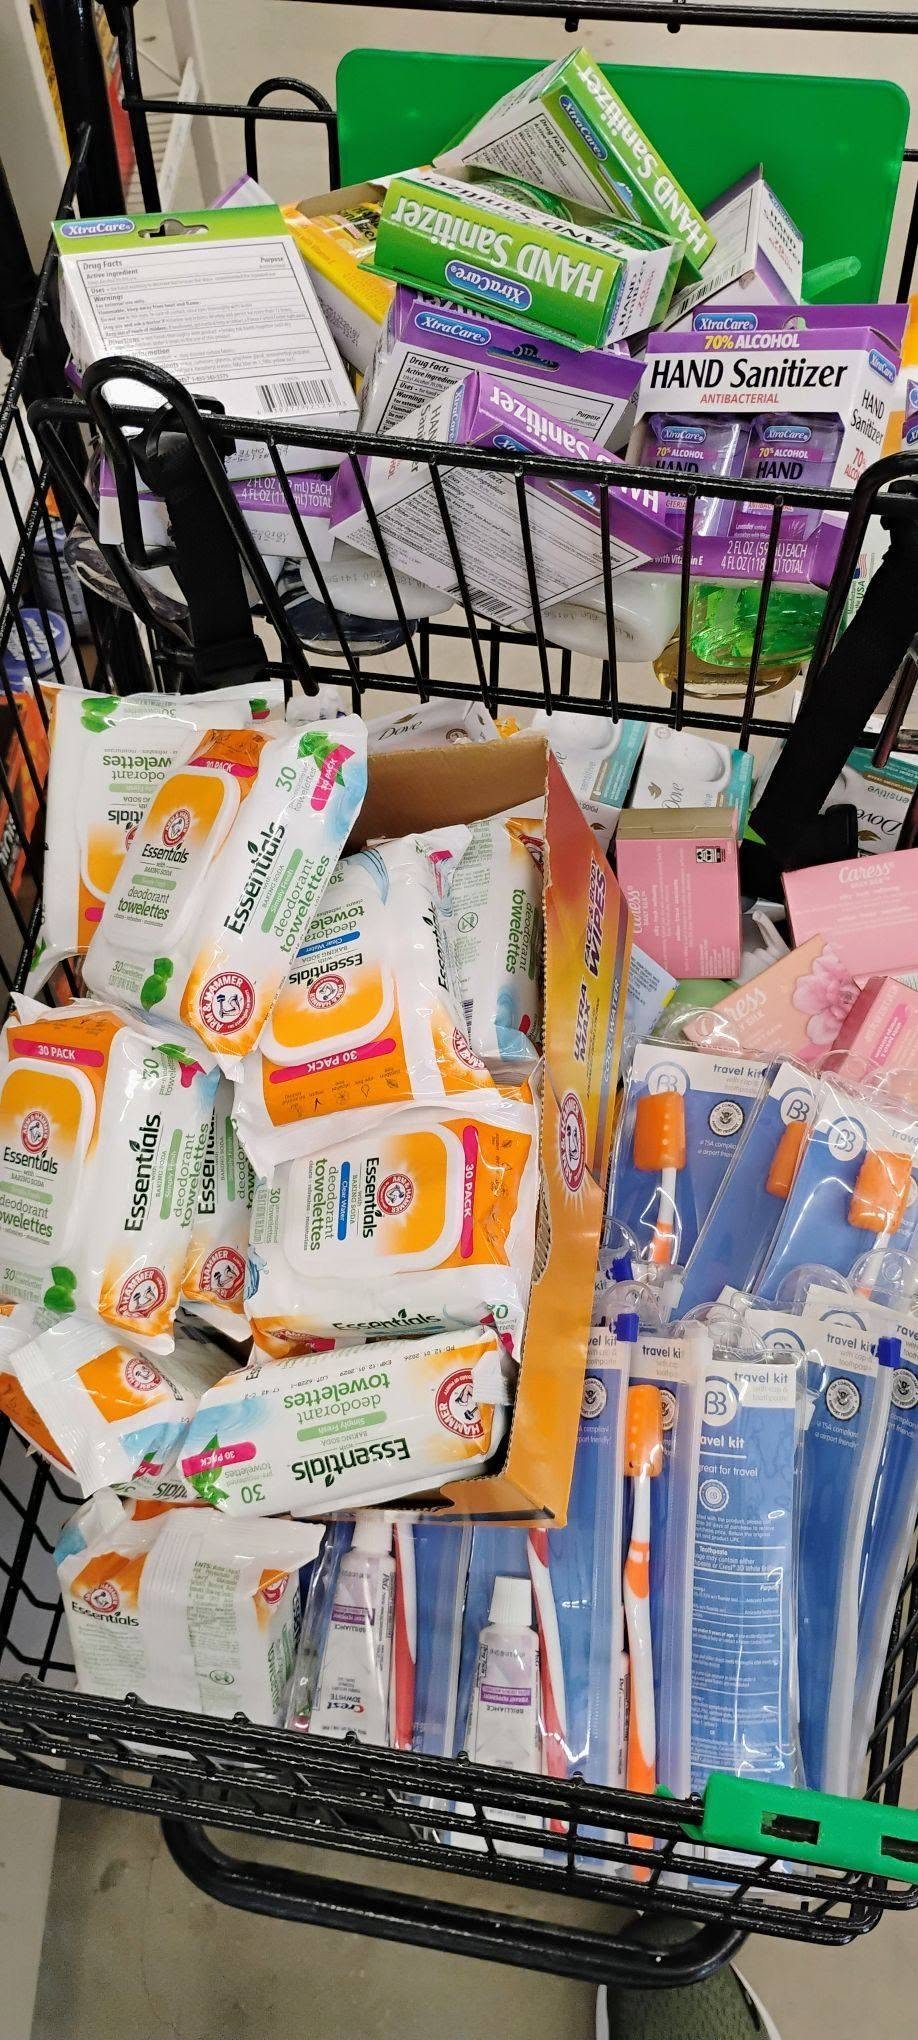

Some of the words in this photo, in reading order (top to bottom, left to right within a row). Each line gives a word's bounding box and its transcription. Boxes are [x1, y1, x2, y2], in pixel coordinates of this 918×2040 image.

[578, 66, 659, 179] Sanitizer
[653, 175, 708, 256] HAND
[392, 196, 514, 269] Sanitizer
[516, 242, 604, 302] HAND
[704, 335, 734, 349] 70%
[735, 334, 800, 349] ALCOHOL
[405, 367, 425, 377] Active
[410, 356, 428, 369] Drug
[428, 361, 450, 373] Facts
[650, 360, 724, 389] HAND
[730, 358, 848, 388] Sanitizer
[396, 391, 426, 403] Warnings
[399, 382, 414, 391] Uses
[700, 394, 780, 404] ANTIBACTERIAL
[861, 389, 885, 419] HAND
[576, 410, 601, 421] Purpose
[850, 409, 884, 446] Sanitizer
[671, 450, 704, 459] ALCOHOL
[774, 449, 809, 458] ALCOHOL
[756, 461, 804, 480] HAND
[264, 478, 276, 489] OZ
[310, 483, 332, 495] EACH
[241, 488, 247, 499] 4
[249, 489, 258, 500] FL
[259, 490, 271, 501] OZ
[309, 495, 332, 508] TOTAL
[727, 541, 734, 553] 2
[734, 541, 744, 553] FL
[744, 541, 755, 555] OZ
[785, 544, 808, 557] EACH
[699, 557, 704, 565] E
[721, 558, 726, 570] 4
[727, 558, 736, 570] FL
[736, 558, 747, 571] OZ
[781, 560, 804, 573] TOTAL
[855, 580, 865, 599] USA
[111, 770, 165, 782] odorant
[275, 766, 297, 792] 30
[324, 759, 339, 782] PACK
[855, 806, 903, 836] Dove
[142, 843, 190, 864] Essentials
[224, 821, 286, 935] Essentials
[329, 872, 344, 886] 30
[839, 864, 892, 884] Caress
[127, 886, 170, 904] deodorant
[274, 858, 315, 938] deodorant
[280, 855, 330, 953] towelettes
[117, 898, 170, 920] towelettes
[304, 920, 357, 944] deodora
[506, 888, 527, 976] towelettes
[588, 871, 606, 977] WIPES
[519, 901, 533, 976] deodorant
[288, 952, 363, 987] Essentials
[204, 974, 244, 1003] HAMMER
[607, 979, 621, 1035] WATER
[204, 1012, 224, 1032] ARM
[574, 981, 587, 1055] ULTRA
[577, 1002, 590, 1063] MAX
[37, 1044, 49, 1056] 30
[50, 1047, 76, 1061] PACK
[306, 1052, 340, 1073] PACK
[341, 1050, 358, 1063] 30
[603, 1042, 613, 1084] COOL
[714, 1064, 744, 1076] travel
[3, 1147, 58, 1175] Essentials
[124, 1111, 161, 1232] Essentials
[464, 1163, 475, 1180] 30
[173, 1131, 197, 1220] deodorant
[180, 1122, 209, 1230] towelettes
[269, 1187, 281, 1204] 30
[341, 1180, 350, 1199] Clear
[362, 1157, 380, 1239] Essentials
[463, 1181, 475, 1218] PACK
[310, 1157, 328, 1252] towelettes
[324, 1166, 339, 1241] deodorant
[339, 1199, 349, 1223] Water
[0, 1211, 53, 1239] owelettes
[3, 1268, 16, 1281] 30
[202, 1249, 230, 1285] HAMMER
[332, 1312, 442, 1332] Essentials
[642, 1345, 671, 1358] travel
[827, 1333, 857, 1349] travel
[734, 1371, 769, 1383] travel
[773, 1371, 788, 1383] kit
[283, 1372, 390, 1409] towelettes
[298, 1394, 382, 1424] deodorant
[439, 1401, 483, 1438] HAMMER
[318, 1421, 340, 1434] Fresh
[340, 1417, 366, 1429] Simply
[728, 1435, 744, 1449] kit
[226, 1450, 236, 1460] 30
[291, 1437, 411, 1484] Essentials
[224, 1463, 272, 1479] towelettes
[719, 1463, 733, 1475] for
[733, 1465, 758, 1477] travel
[241, 1484, 266, 1504] 30
[71, 1600, 140, 1627] Essentials
[326, 1701, 365, 1713] Crest
[486, 1704, 525, 1714] BRILLIANCE
